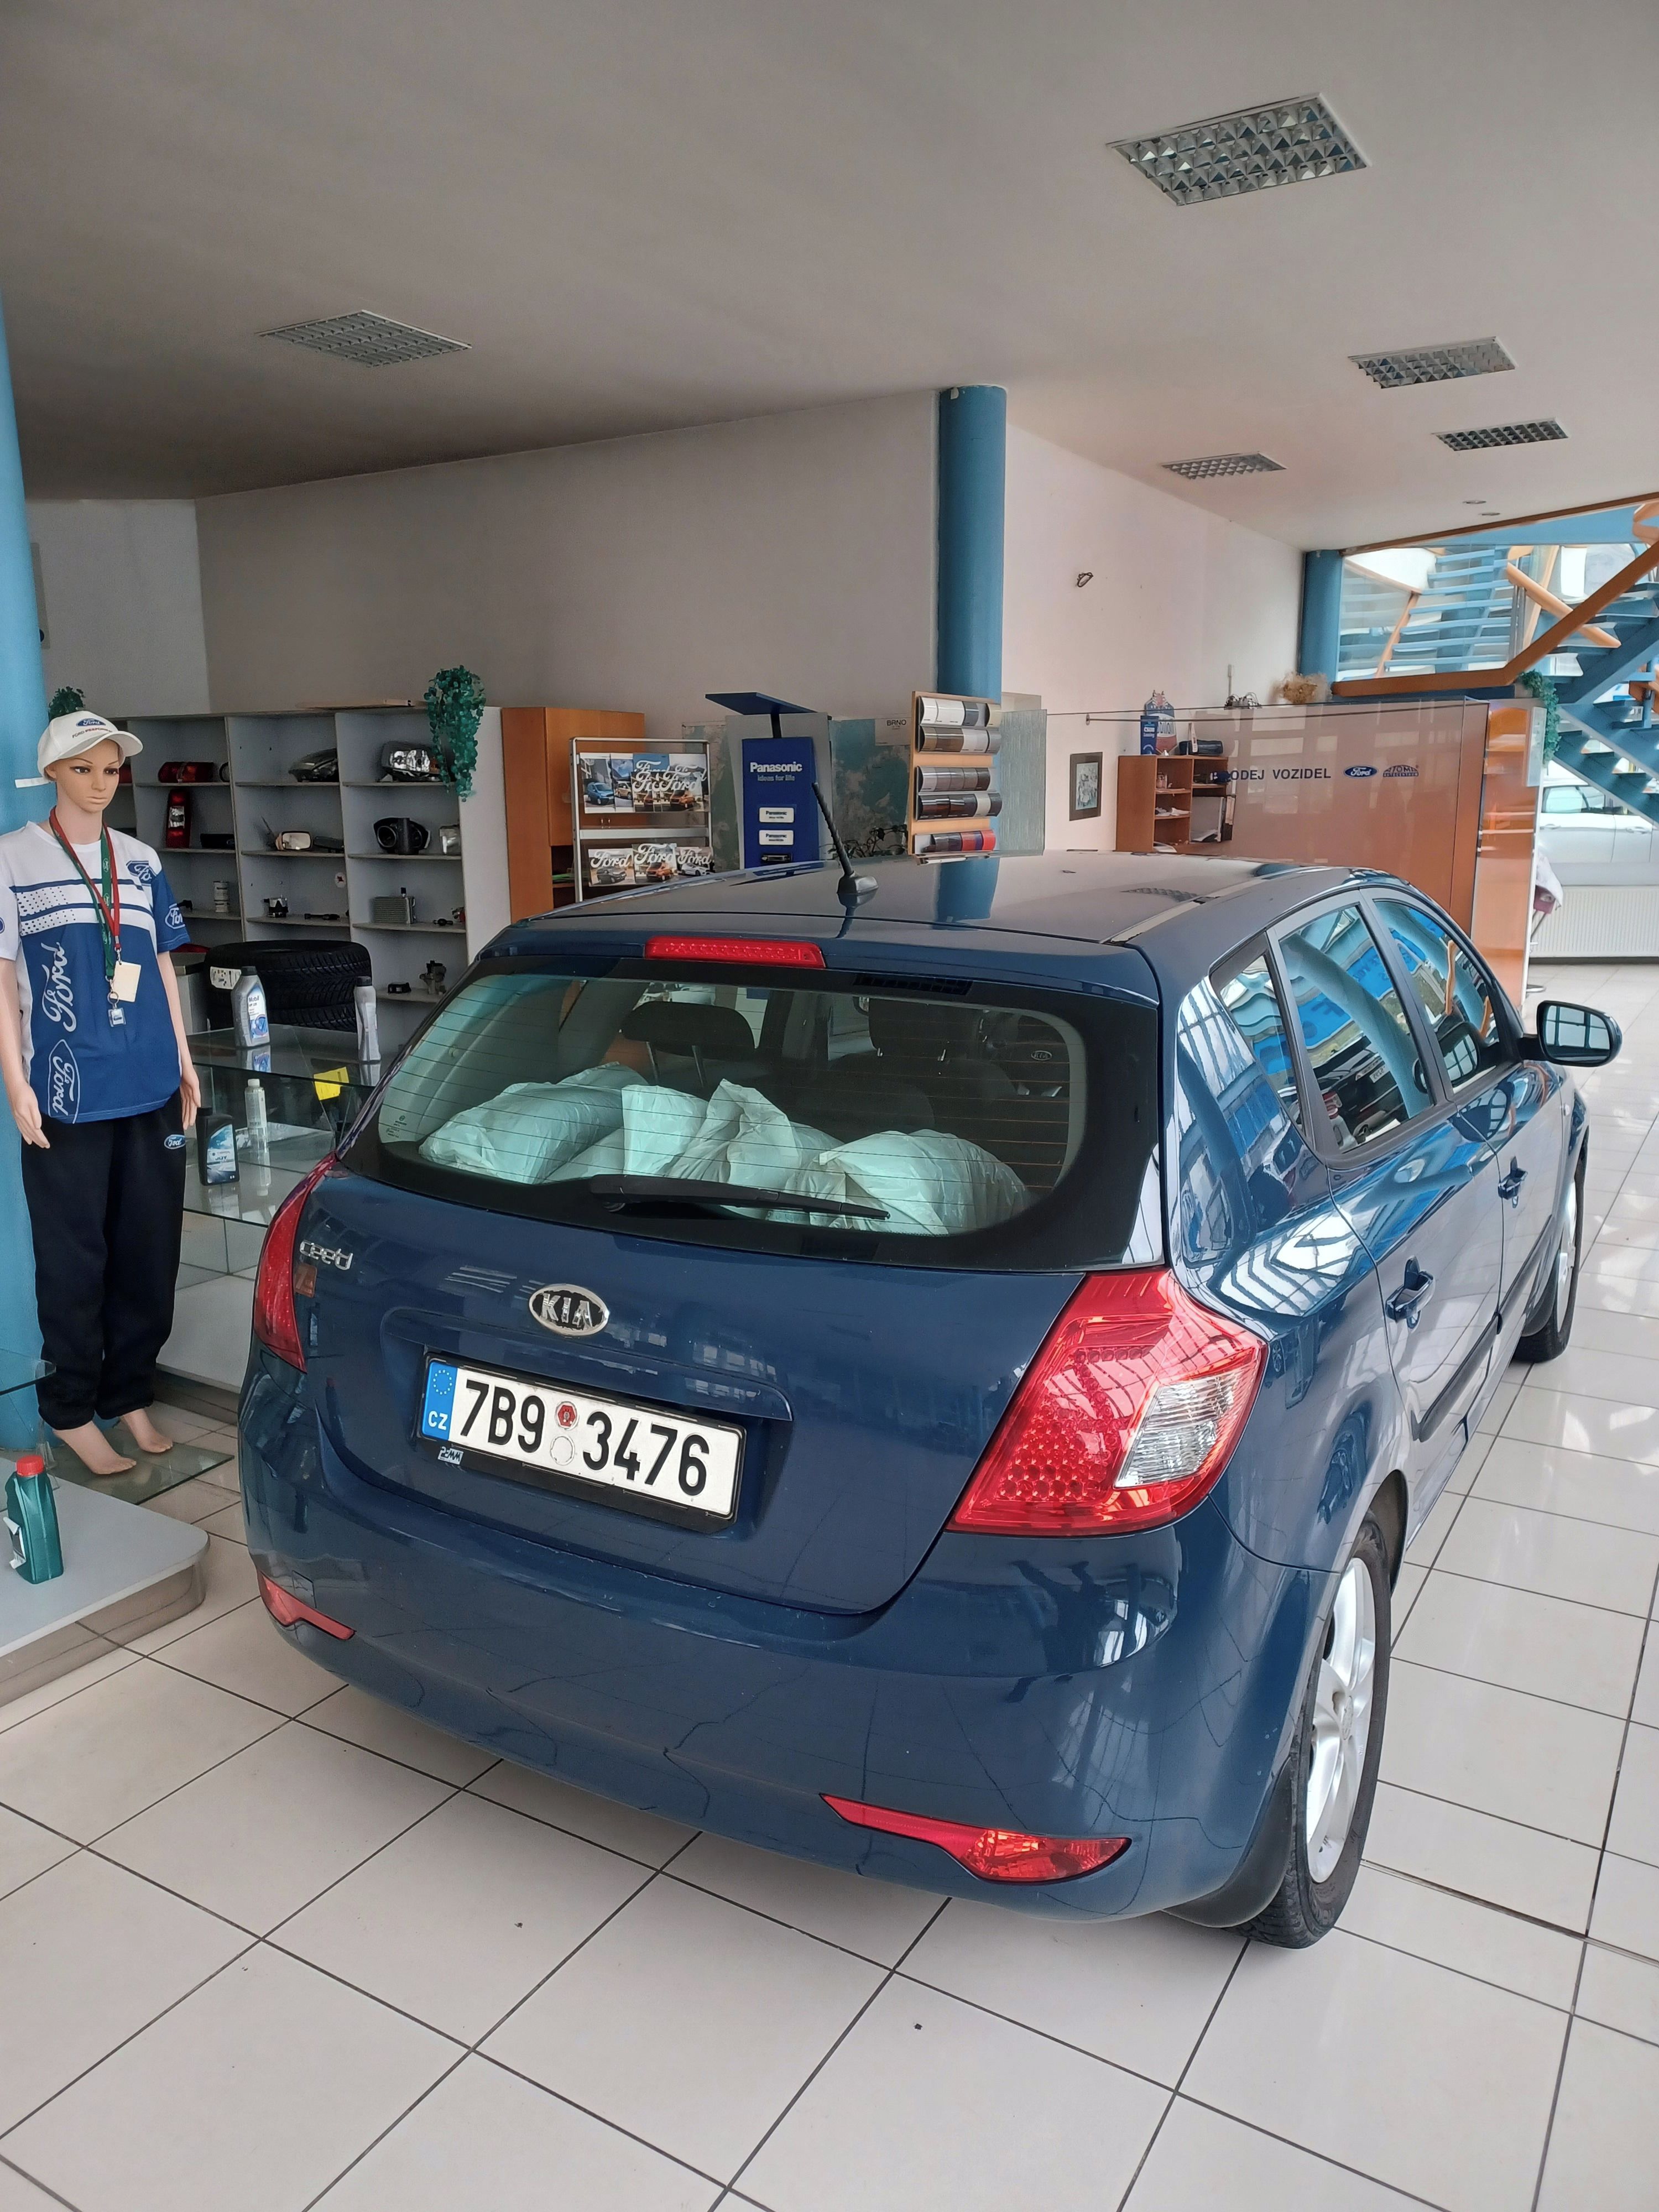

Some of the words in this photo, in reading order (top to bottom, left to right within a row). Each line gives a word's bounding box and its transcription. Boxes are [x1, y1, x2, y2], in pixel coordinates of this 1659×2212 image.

[750, 761, 803, 773] Panasonic
[1272, 768, 1332, 780] VOZIDEL
[1350, 767, 1372, 776] Ford
[591, 849, 632, 868] Ford
[634, 843, 676, 865] Ford
[677, 848, 712, 865] Ford
[40, 942, 77, 1032] Ford
[52, 1056, 75, 1117] Ford
[540, 1292, 593, 1328] KIA
[428, 1410, 447, 1431] CZ
[460, 1379, 546, 1453] 7B9
[582, 1411, 711, 1496] 3476
